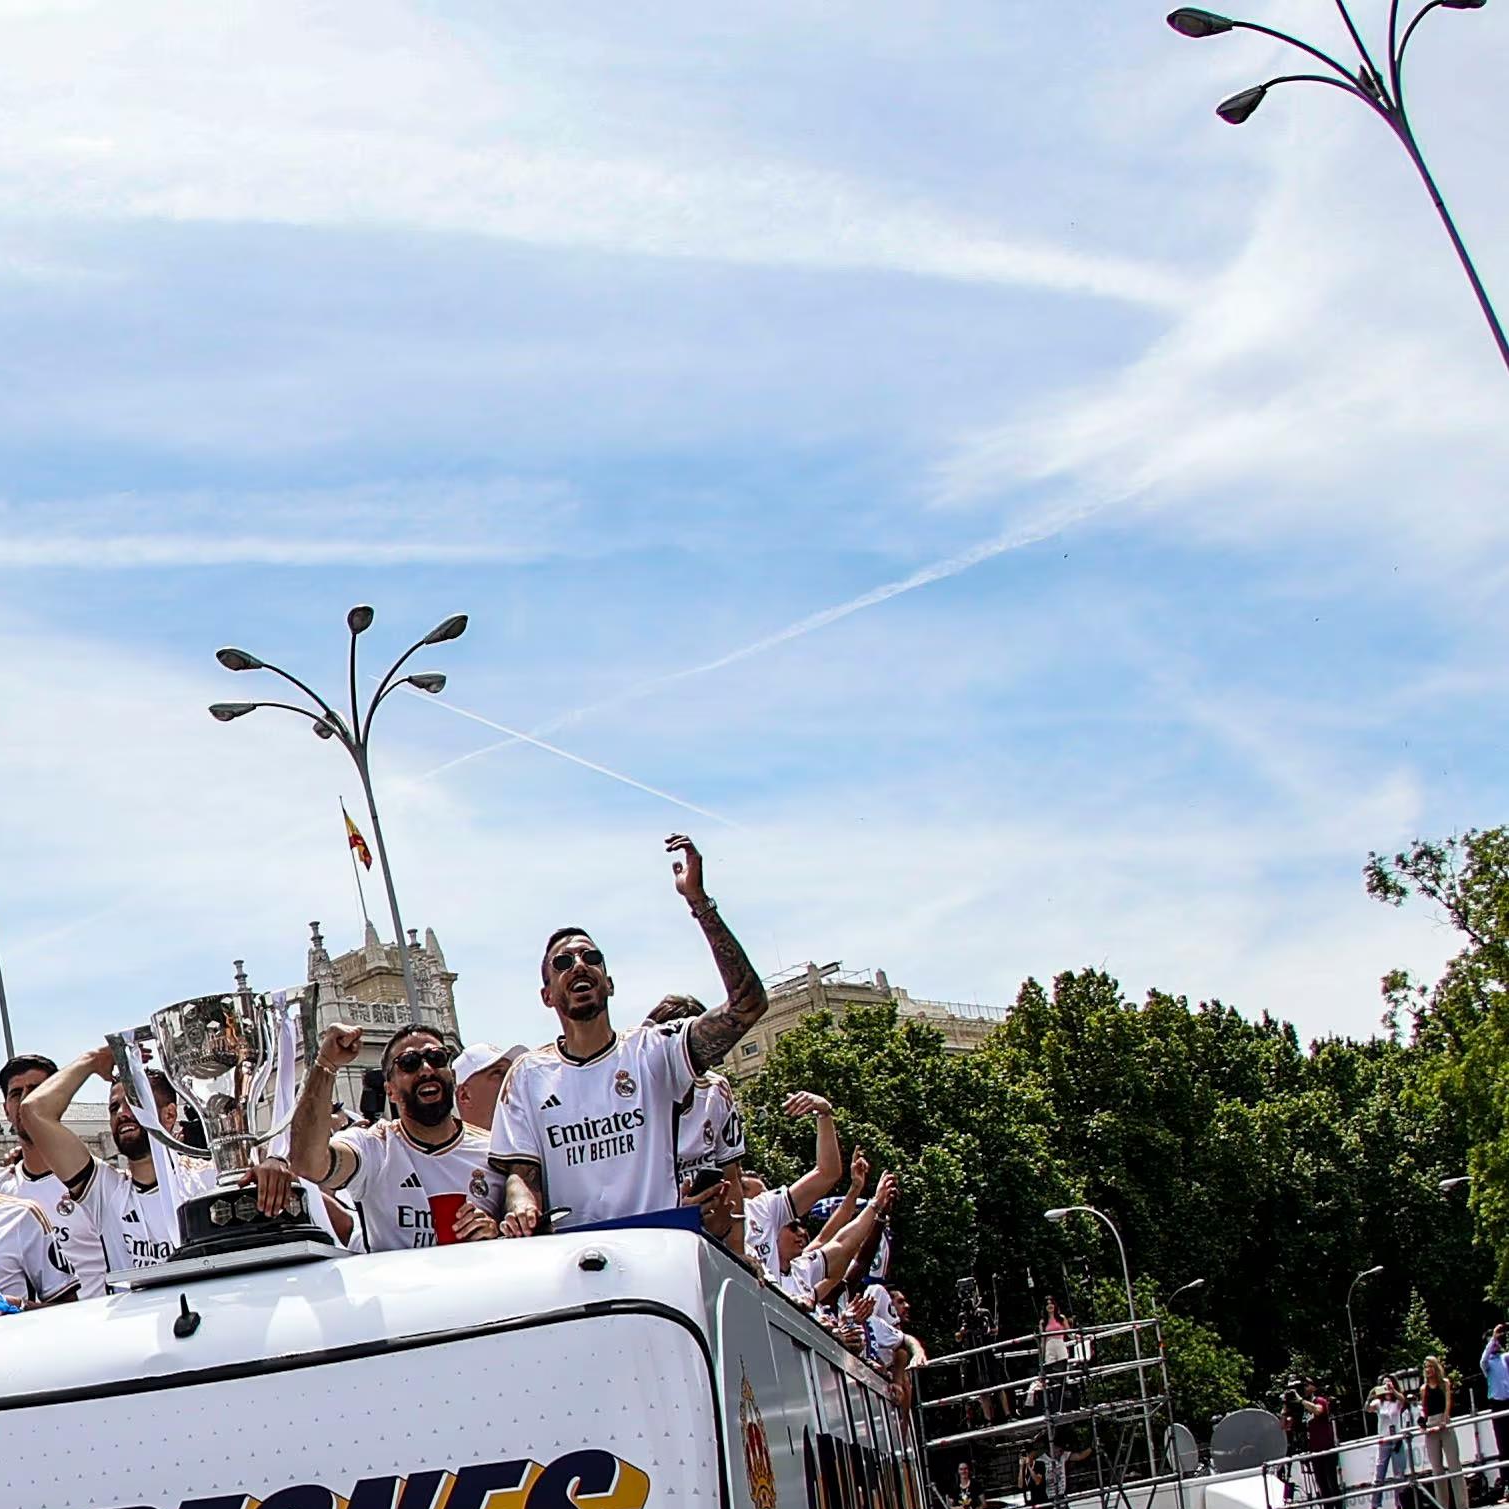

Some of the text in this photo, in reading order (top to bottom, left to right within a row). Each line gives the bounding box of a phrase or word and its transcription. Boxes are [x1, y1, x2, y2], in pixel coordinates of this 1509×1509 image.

[546, 1108, 645, 1148] Emirates
[566, 1133, 635, 1167] FLY BETTER
[123, 1233, 173, 1260] Emira
